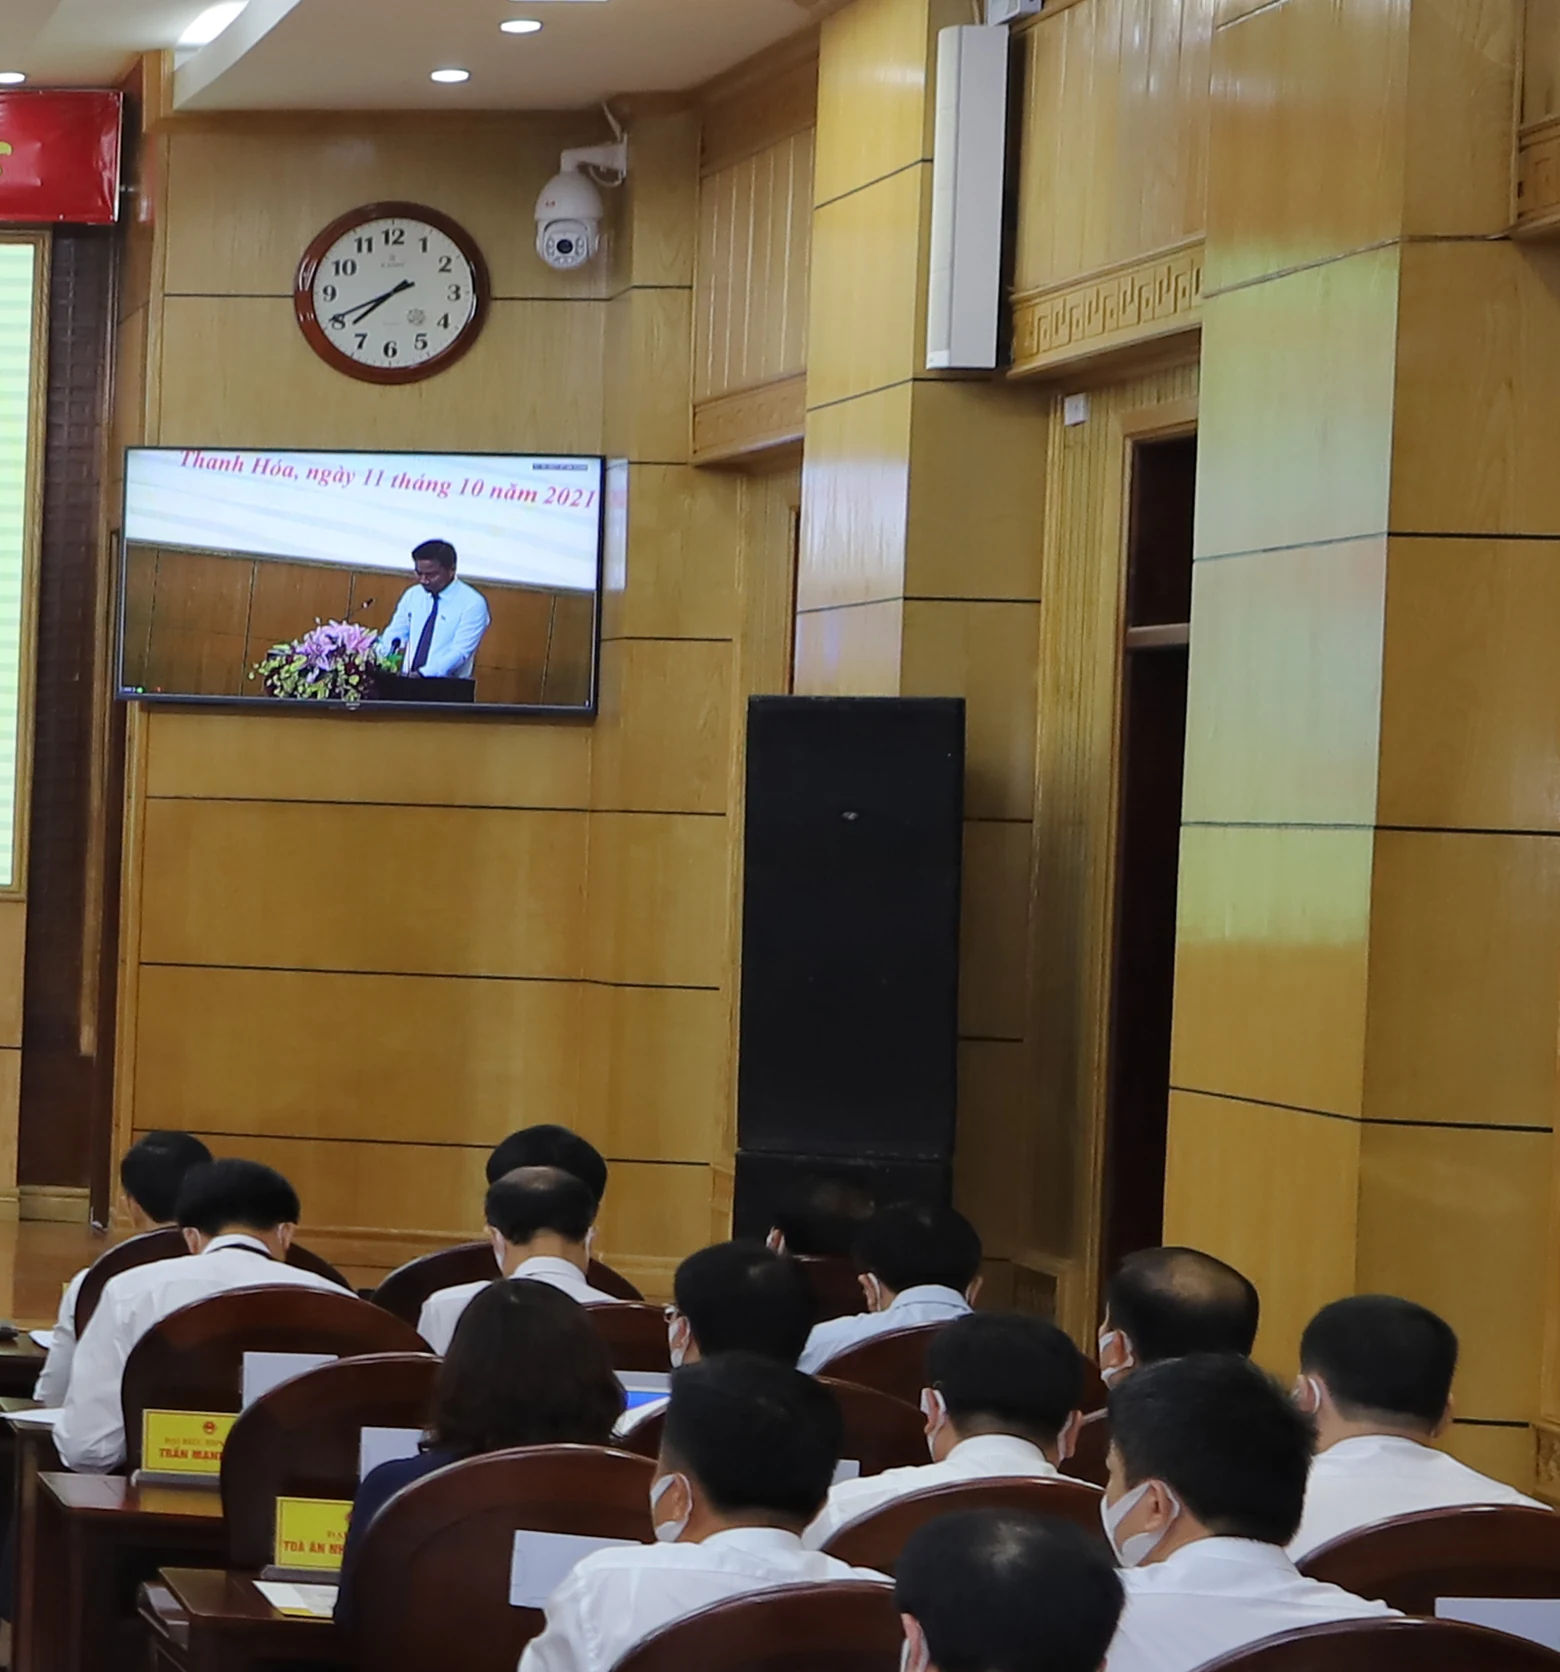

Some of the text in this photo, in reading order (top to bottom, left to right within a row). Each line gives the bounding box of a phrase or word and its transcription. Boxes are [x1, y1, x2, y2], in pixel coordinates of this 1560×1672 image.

[354, 237, 376, 254] 11
[381, 228, 406, 246] 12
[418, 236, 430, 254] 1
[332, 258, 357, 277] 10
[437, 255, 453, 273] 2
[322, 283, 337, 302] 9
[447, 283, 462, 302] 3
[436, 312, 451, 330] 4
[354, 332, 368, 351] 7
[382, 340, 398, 359] 6
[413, 332, 428, 351] 5
[179, 450, 599, 510] Thanh Hóa, ngày 11 tháng 10 năm 2021
